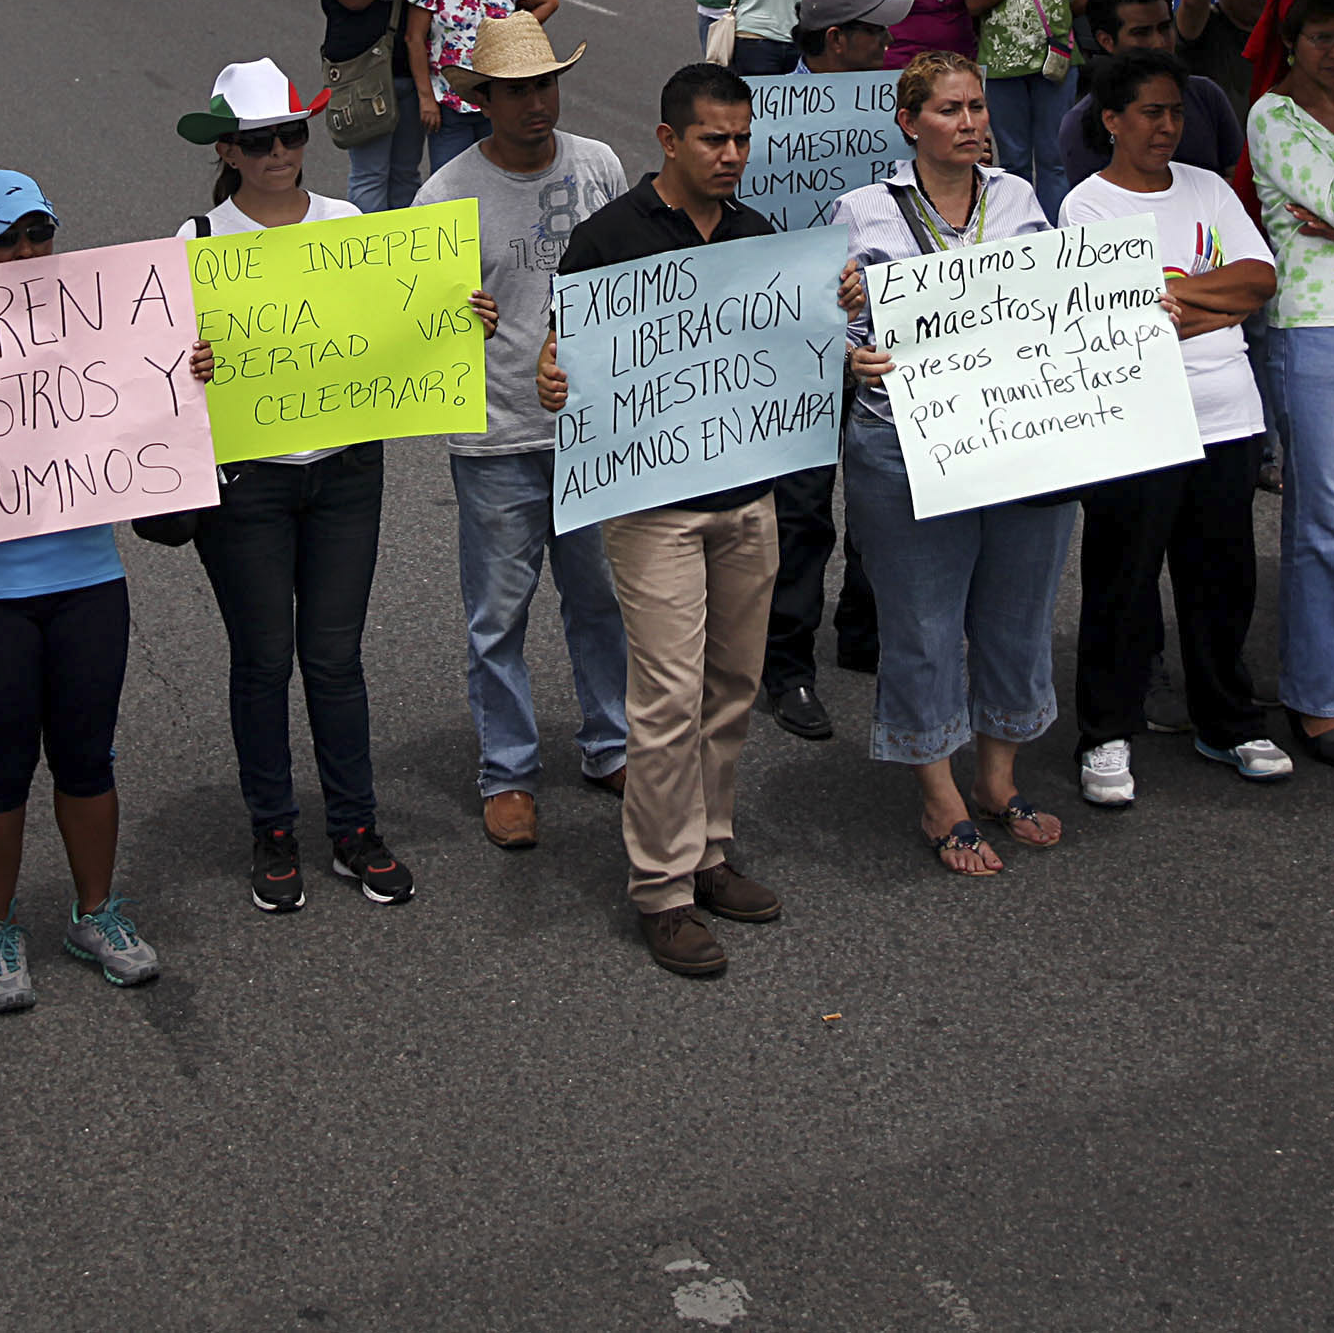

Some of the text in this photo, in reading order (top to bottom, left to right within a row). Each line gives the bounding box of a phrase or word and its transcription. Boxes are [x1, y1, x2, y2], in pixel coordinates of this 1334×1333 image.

[751, 85, 835, 120] XIGIMOS
[768, 128, 888, 165] MAESTROS
[738, 166, 846, 200] LUMNOS
[194, 219, 476, 290] QUÉ INDEPEN-
[880, 226, 1154, 305] Exigimos liberen
[130, 263, 175, 329] A
[396, 274, 418, 311] Y
[417, 305, 472, 340] VAS
[557, 257, 698, 339] EXIGIMOS
[612, 271, 802, 377] LIBERACIÓN
[885, 329, 899, 349] a
[1067, 282, 1162, 316] Alumnos
[144, 349, 187, 418] Y
[899, 316, 1169, 400] presos en Jalapa
[255, 362, 471, 425] CELEBRAR?
[559, 337, 835, 453] DE MAESTROS Y
[910, 357, 1142, 439] por manifestarse
[560, 392, 836, 505] ALUMNOS EN XALAPA
